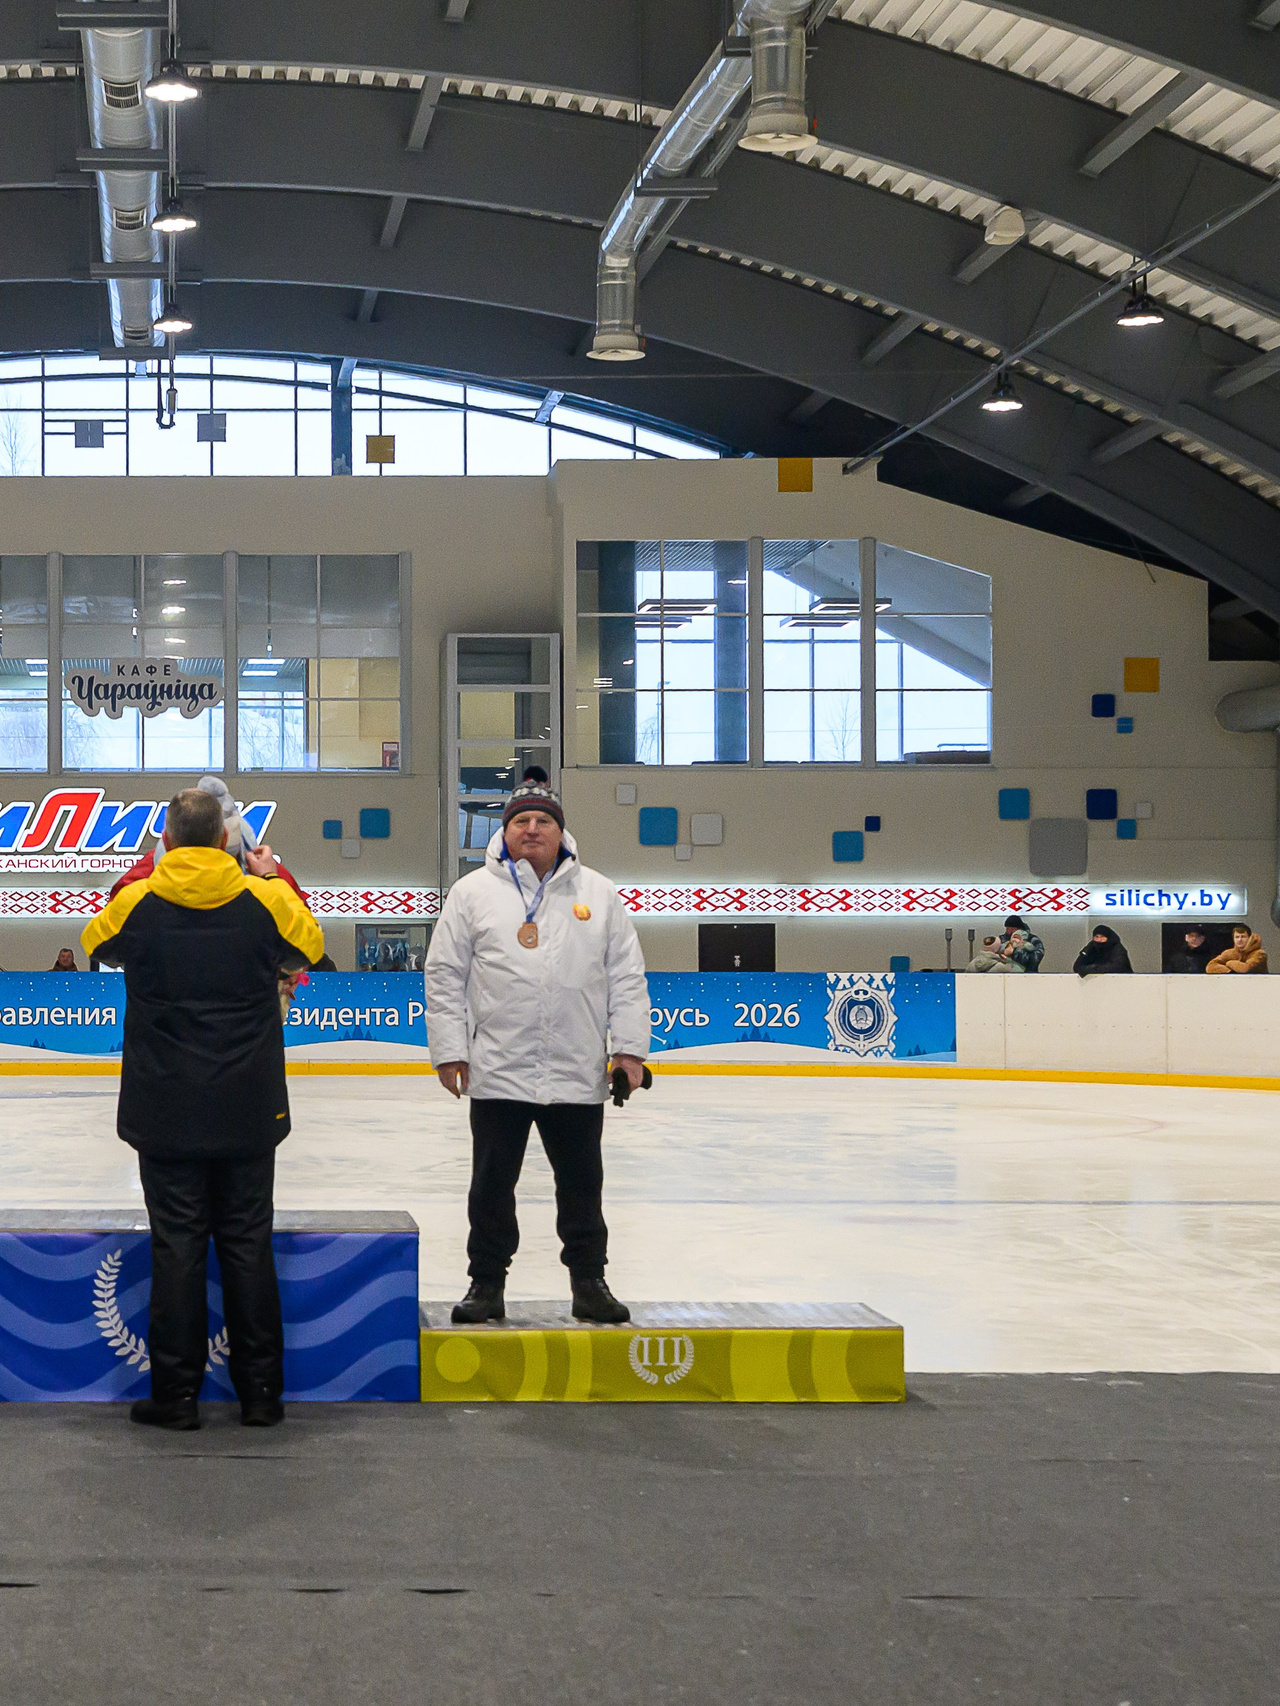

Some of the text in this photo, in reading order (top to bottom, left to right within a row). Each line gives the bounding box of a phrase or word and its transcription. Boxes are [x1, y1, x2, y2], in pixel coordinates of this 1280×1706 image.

[117, 664, 171, 677] КАФЕ
[71, 675, 218, 713] Чараўніца
[1105, 889, 1232, 910] silichy.by
[733, 1003, 801, 1028] 2026
[639, 1337, 683, 1366] III
